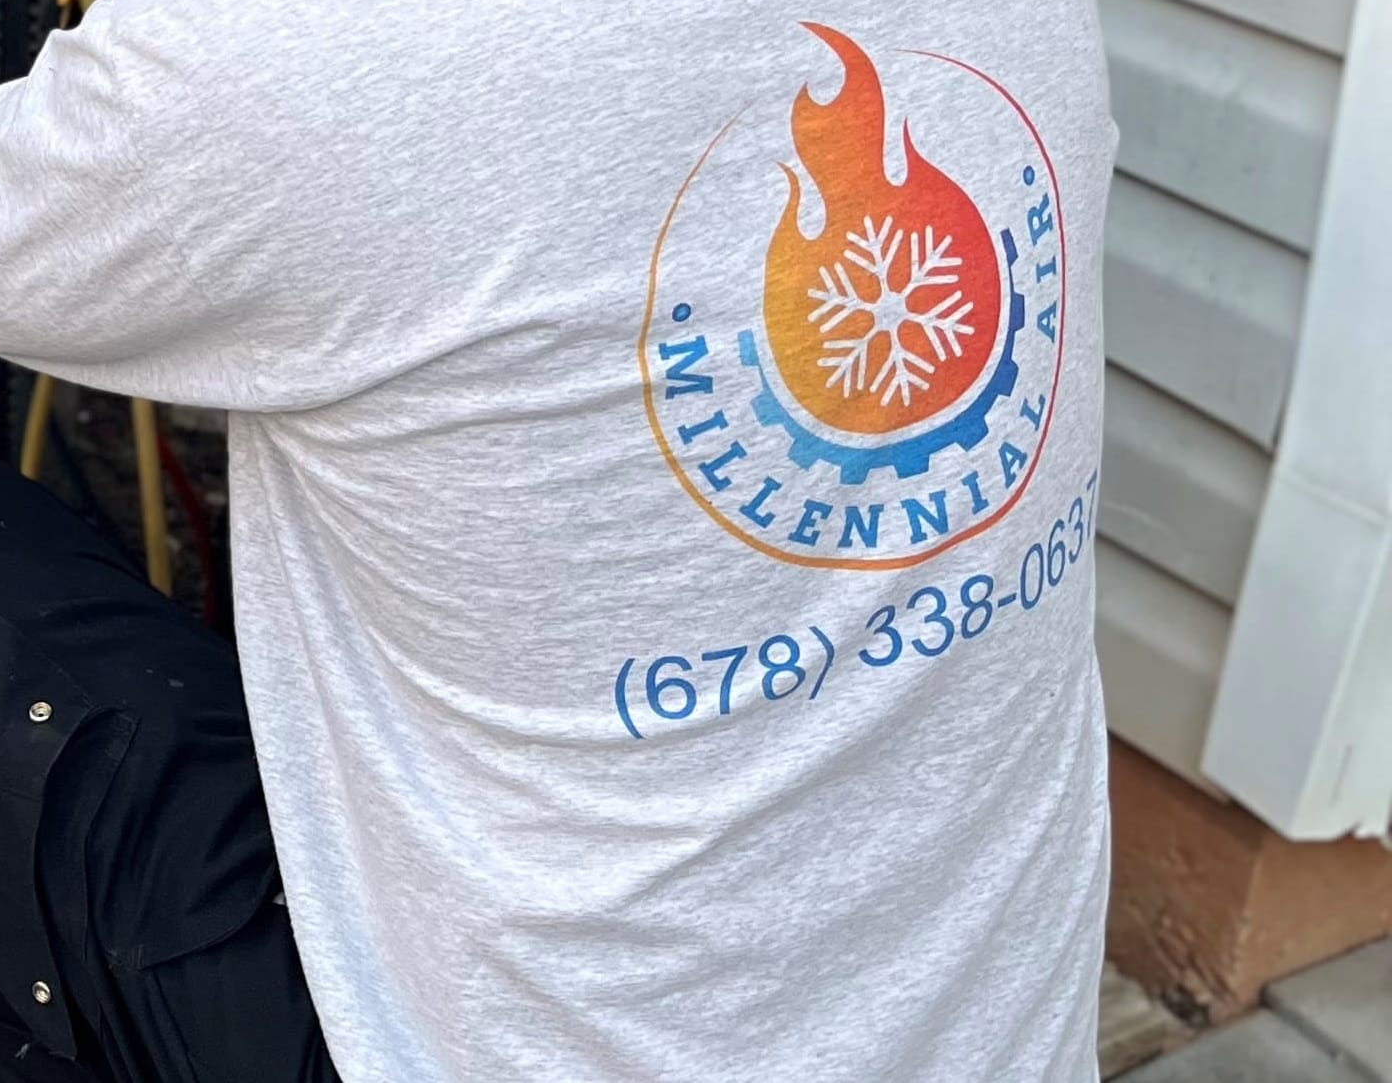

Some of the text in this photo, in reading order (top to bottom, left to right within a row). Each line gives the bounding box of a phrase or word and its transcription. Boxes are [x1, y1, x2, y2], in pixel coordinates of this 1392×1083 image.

[658, 192, 1058, 550] MILLENNIAL AIR
[613, 467, 1098, 740] (678) 338-0637
